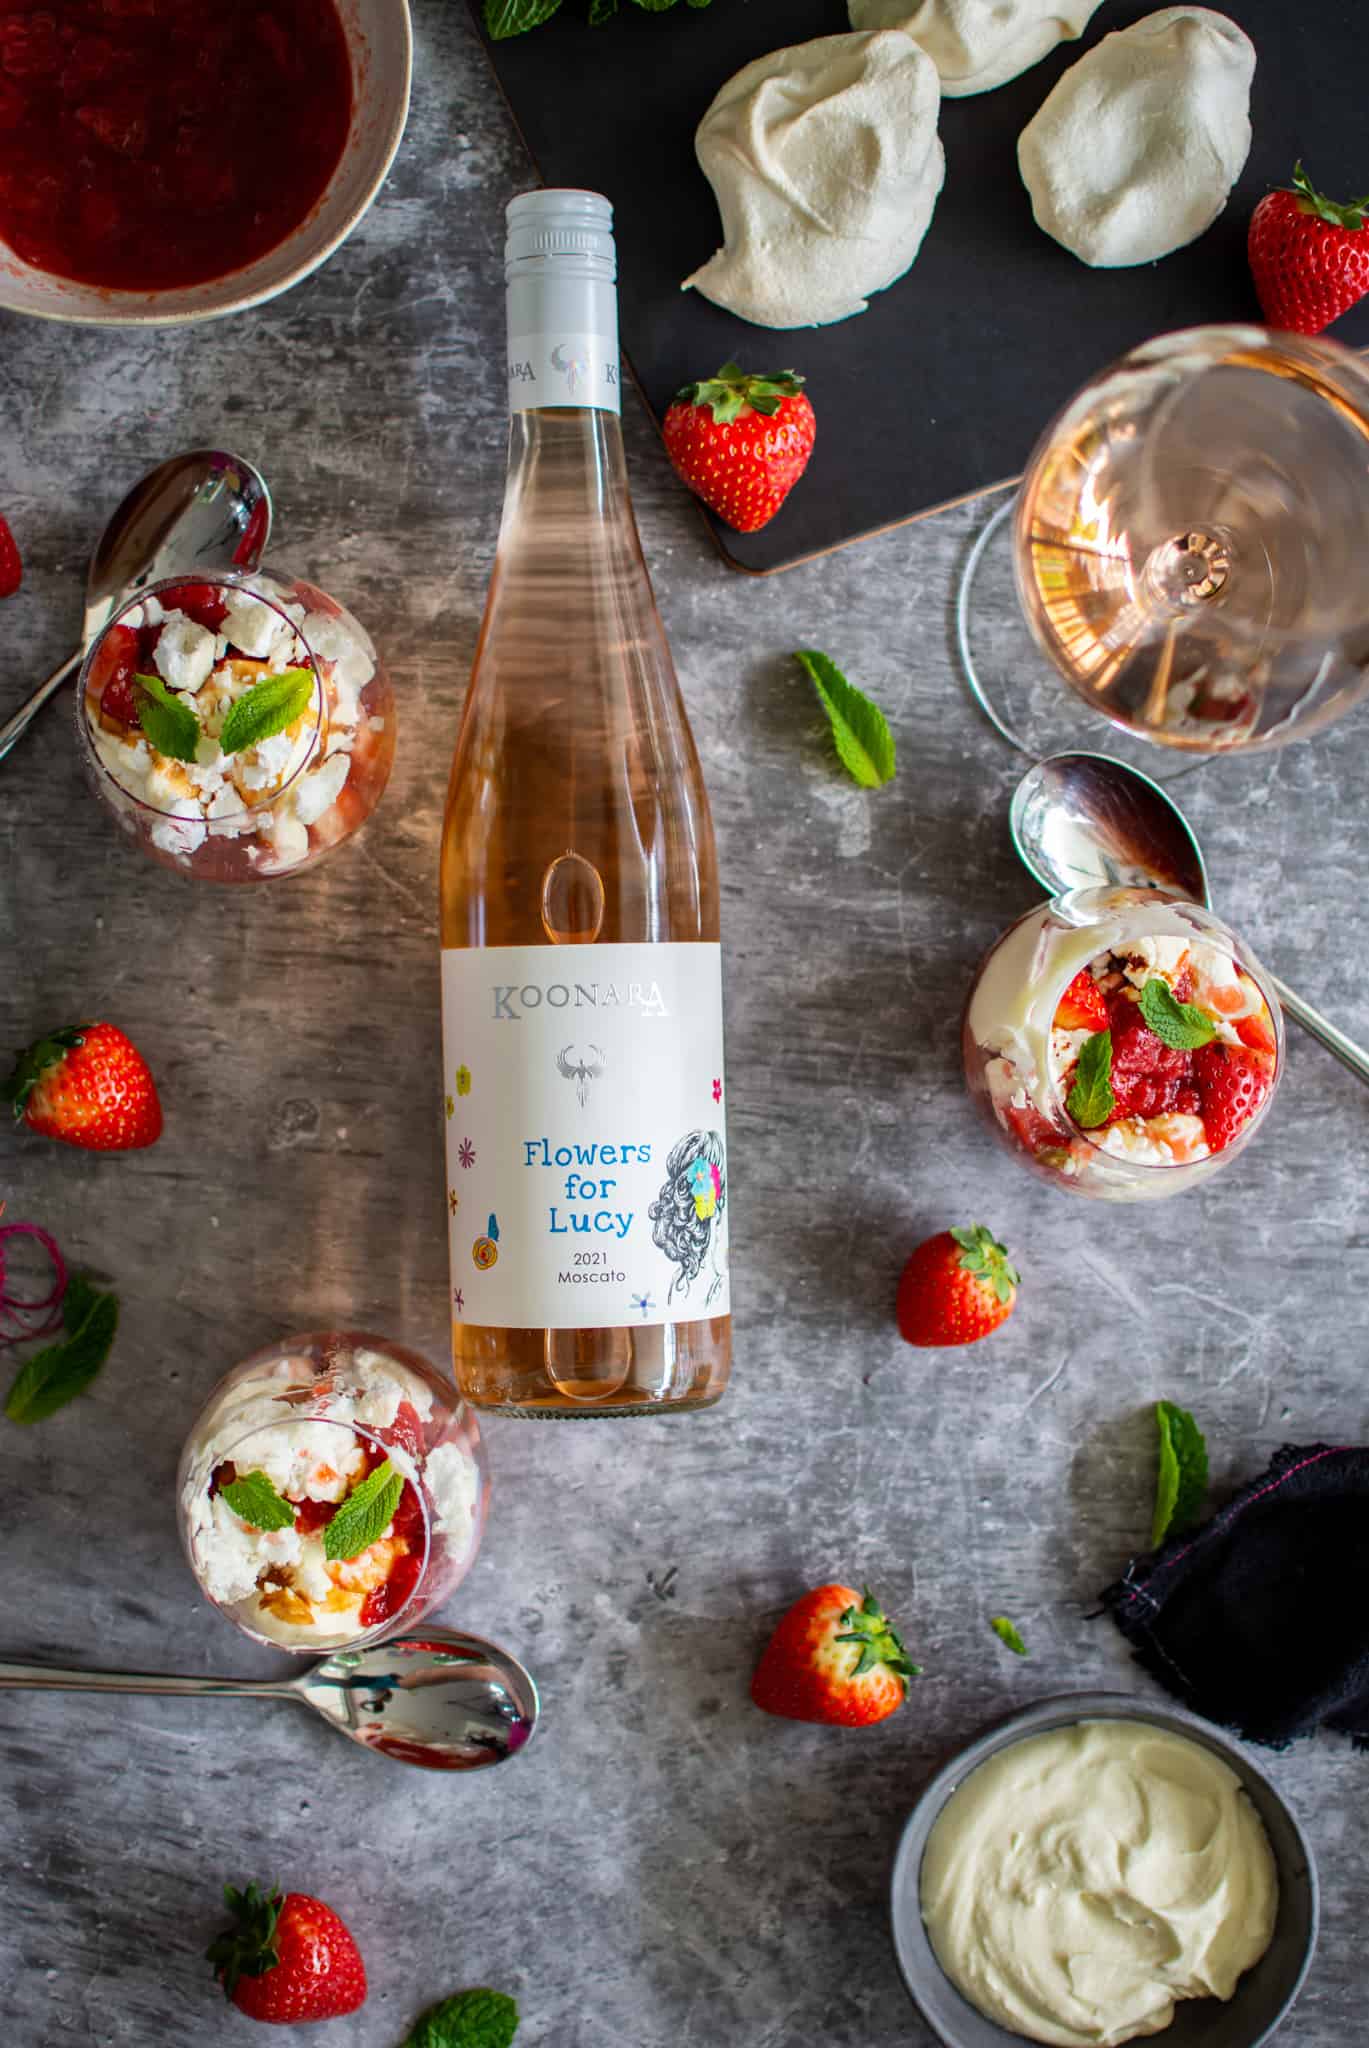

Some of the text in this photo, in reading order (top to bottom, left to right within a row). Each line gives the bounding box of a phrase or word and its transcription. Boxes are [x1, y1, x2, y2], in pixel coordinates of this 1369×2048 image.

[491, 980, 671, 1020] KOONARA
[523, 1138, 651, 1166] Flowers
[564, 1173, 616, 1199] for
[549, 1207, 634, 1238] Lucy
[573, 1252, 608, 1265] 2021
[557, 1269, 626, 1283] Moscato
